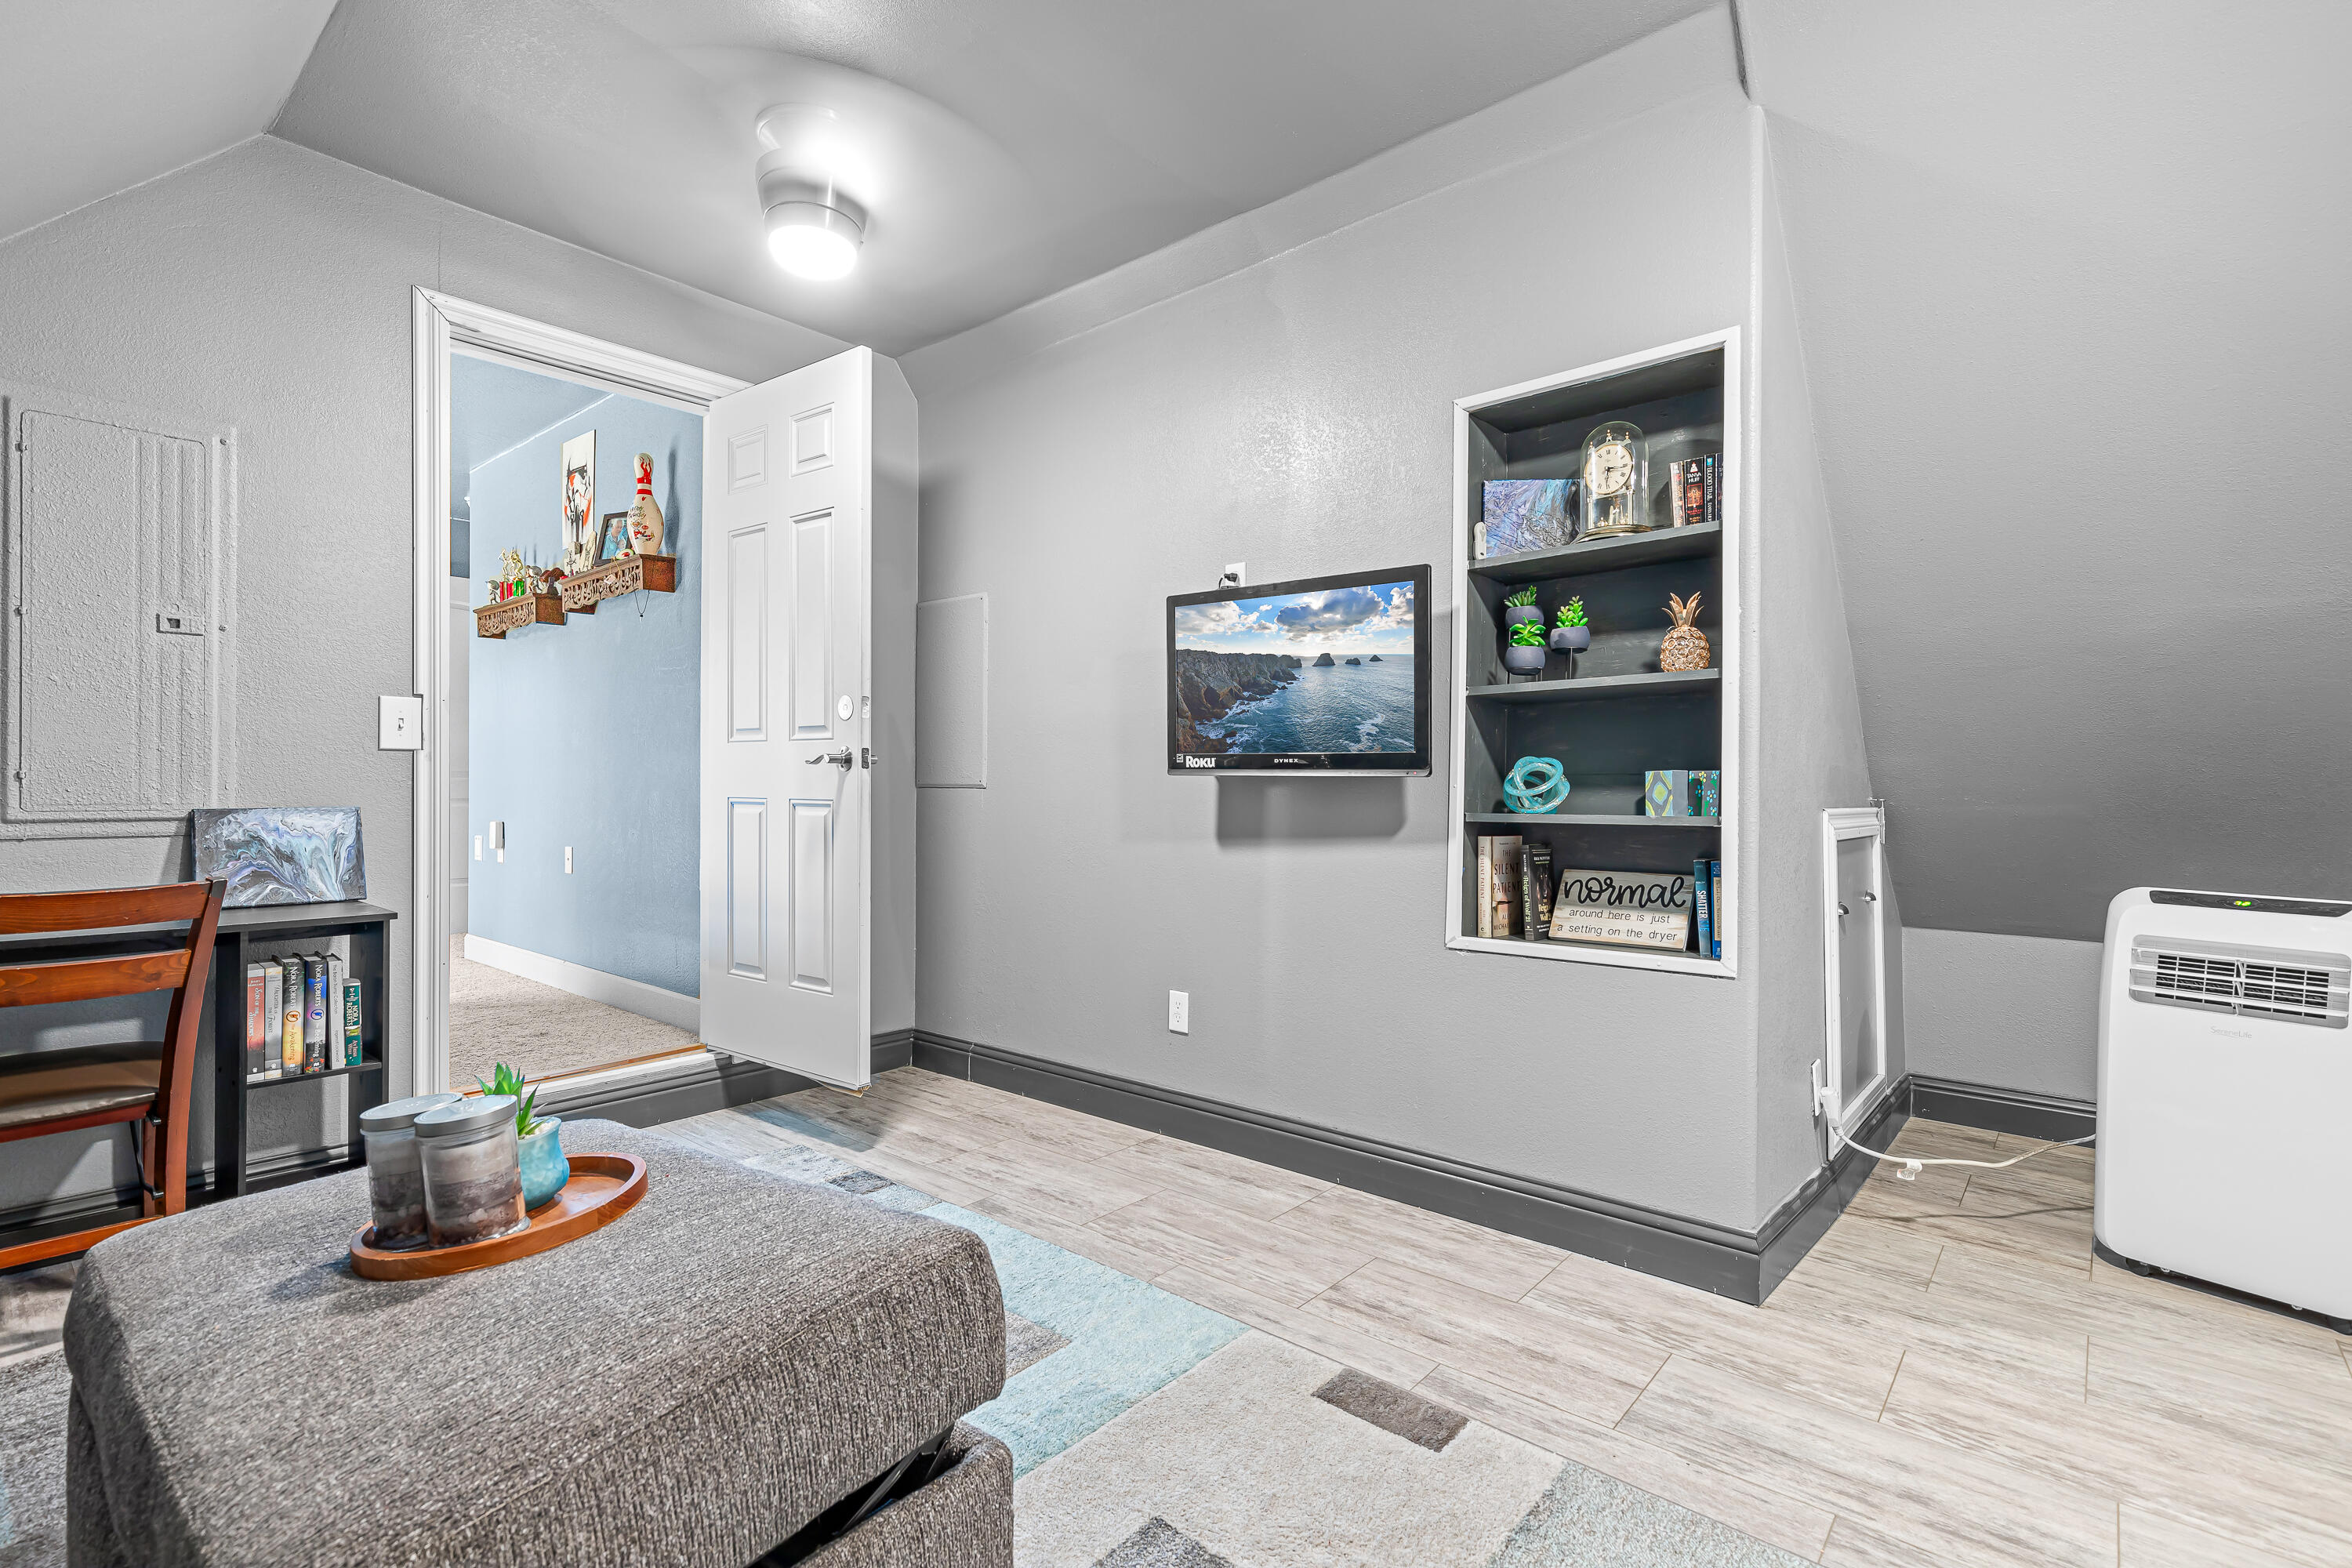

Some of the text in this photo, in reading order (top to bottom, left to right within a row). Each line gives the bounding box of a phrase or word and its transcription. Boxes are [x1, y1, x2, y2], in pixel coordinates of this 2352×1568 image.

[1494, 862, 1519, 875] SILENT
[1493, 881, 1522, 894] PATIENT
[1564, 876, 1686, 909] normal
[1697, 891, 1708, 919] SHATTER
[1570, 909, 1670, 924] around here is just
[1568, 924, 1602, 936] setting
[1607, 927, 1620, 936] on
[1626, 928, 1643, 938] the
[1649, 931, 1678, 942] dryer
[289, 966, 299, 1008] NORA ROBERTS
[314, 983, 323, 1007] ROBERTS
[2210, 1025, 2252, 1039] SereneLife
